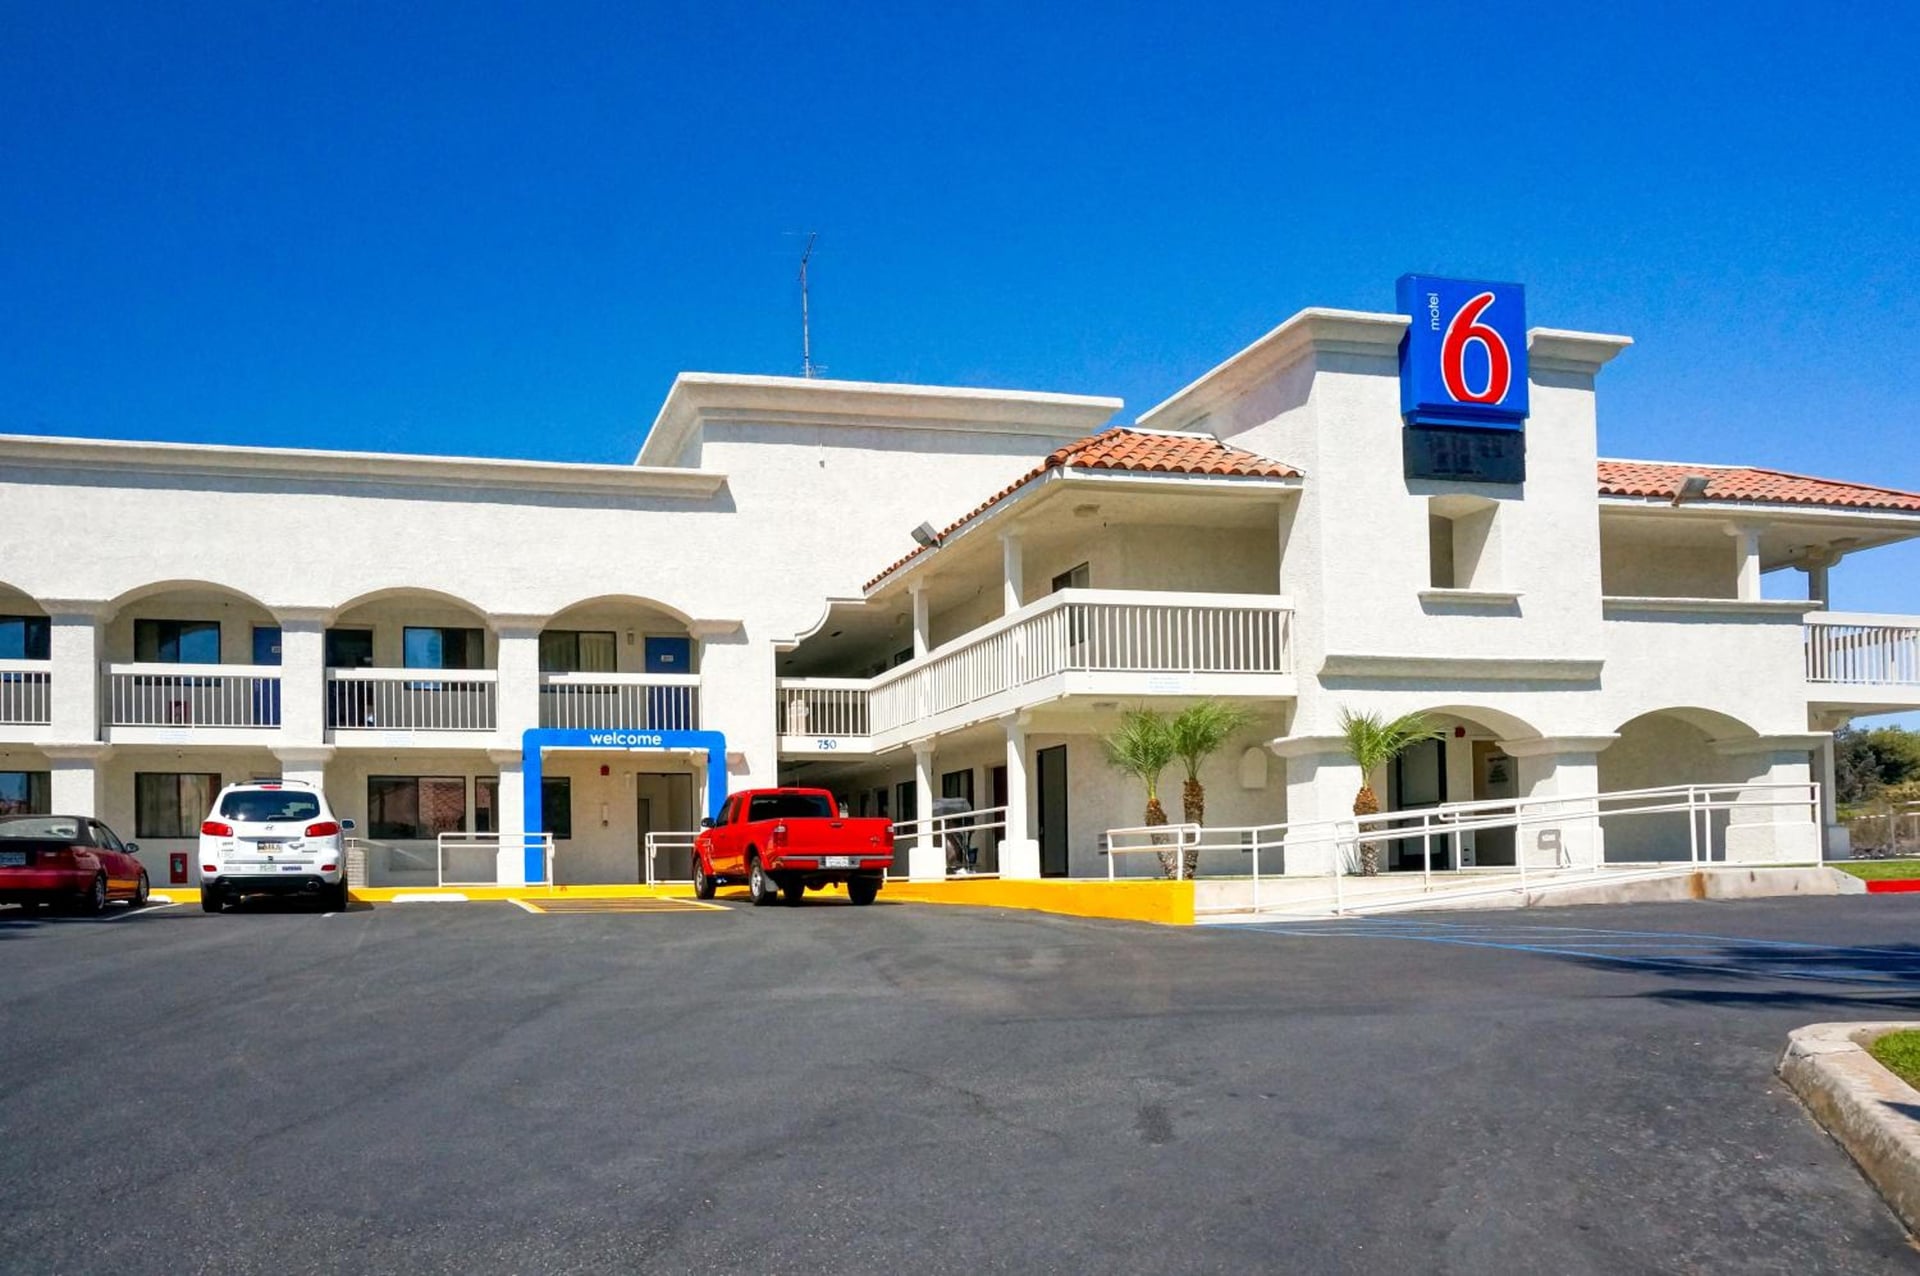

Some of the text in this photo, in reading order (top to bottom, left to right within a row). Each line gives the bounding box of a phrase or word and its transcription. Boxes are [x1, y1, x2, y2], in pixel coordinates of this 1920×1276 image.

[1427, 292, 1441, 331] motel
[1440, 291, 1512, 405] 6
[589, 731, 663, 746] welcome
[817, 739, 838, 750] 750
